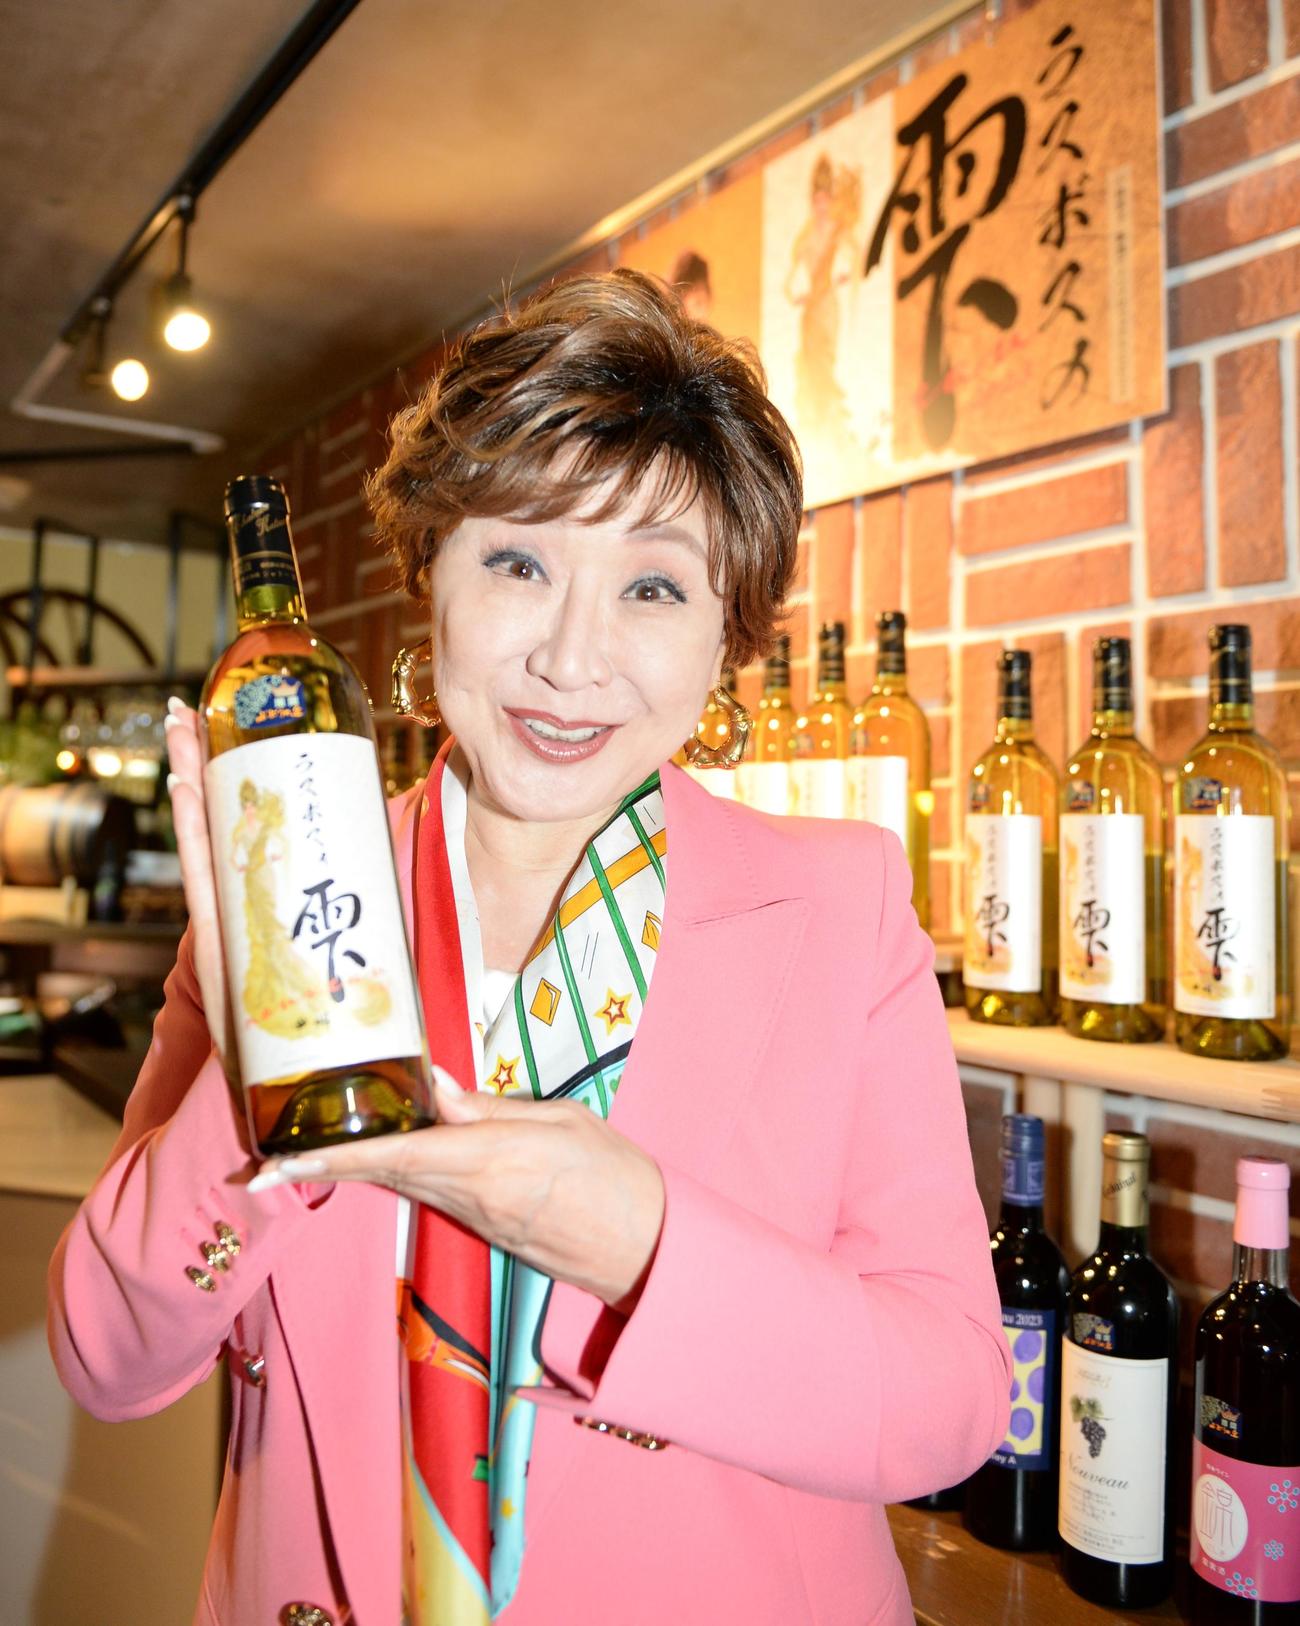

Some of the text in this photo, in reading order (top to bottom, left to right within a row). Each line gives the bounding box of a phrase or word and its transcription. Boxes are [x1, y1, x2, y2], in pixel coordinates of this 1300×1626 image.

[1037, 24, 1091, 411] ラスボスの
[865, 72, 1027, 450] 雫
[291, 878, 367, 1003] 雫
[1073, 900, 1111, 968] 雫
[1197, 907, 1240, 982] 雫
[1015, 1313, 1044, 1327] 2023
[1061, 1451, 1129, 1489] Nouveau
